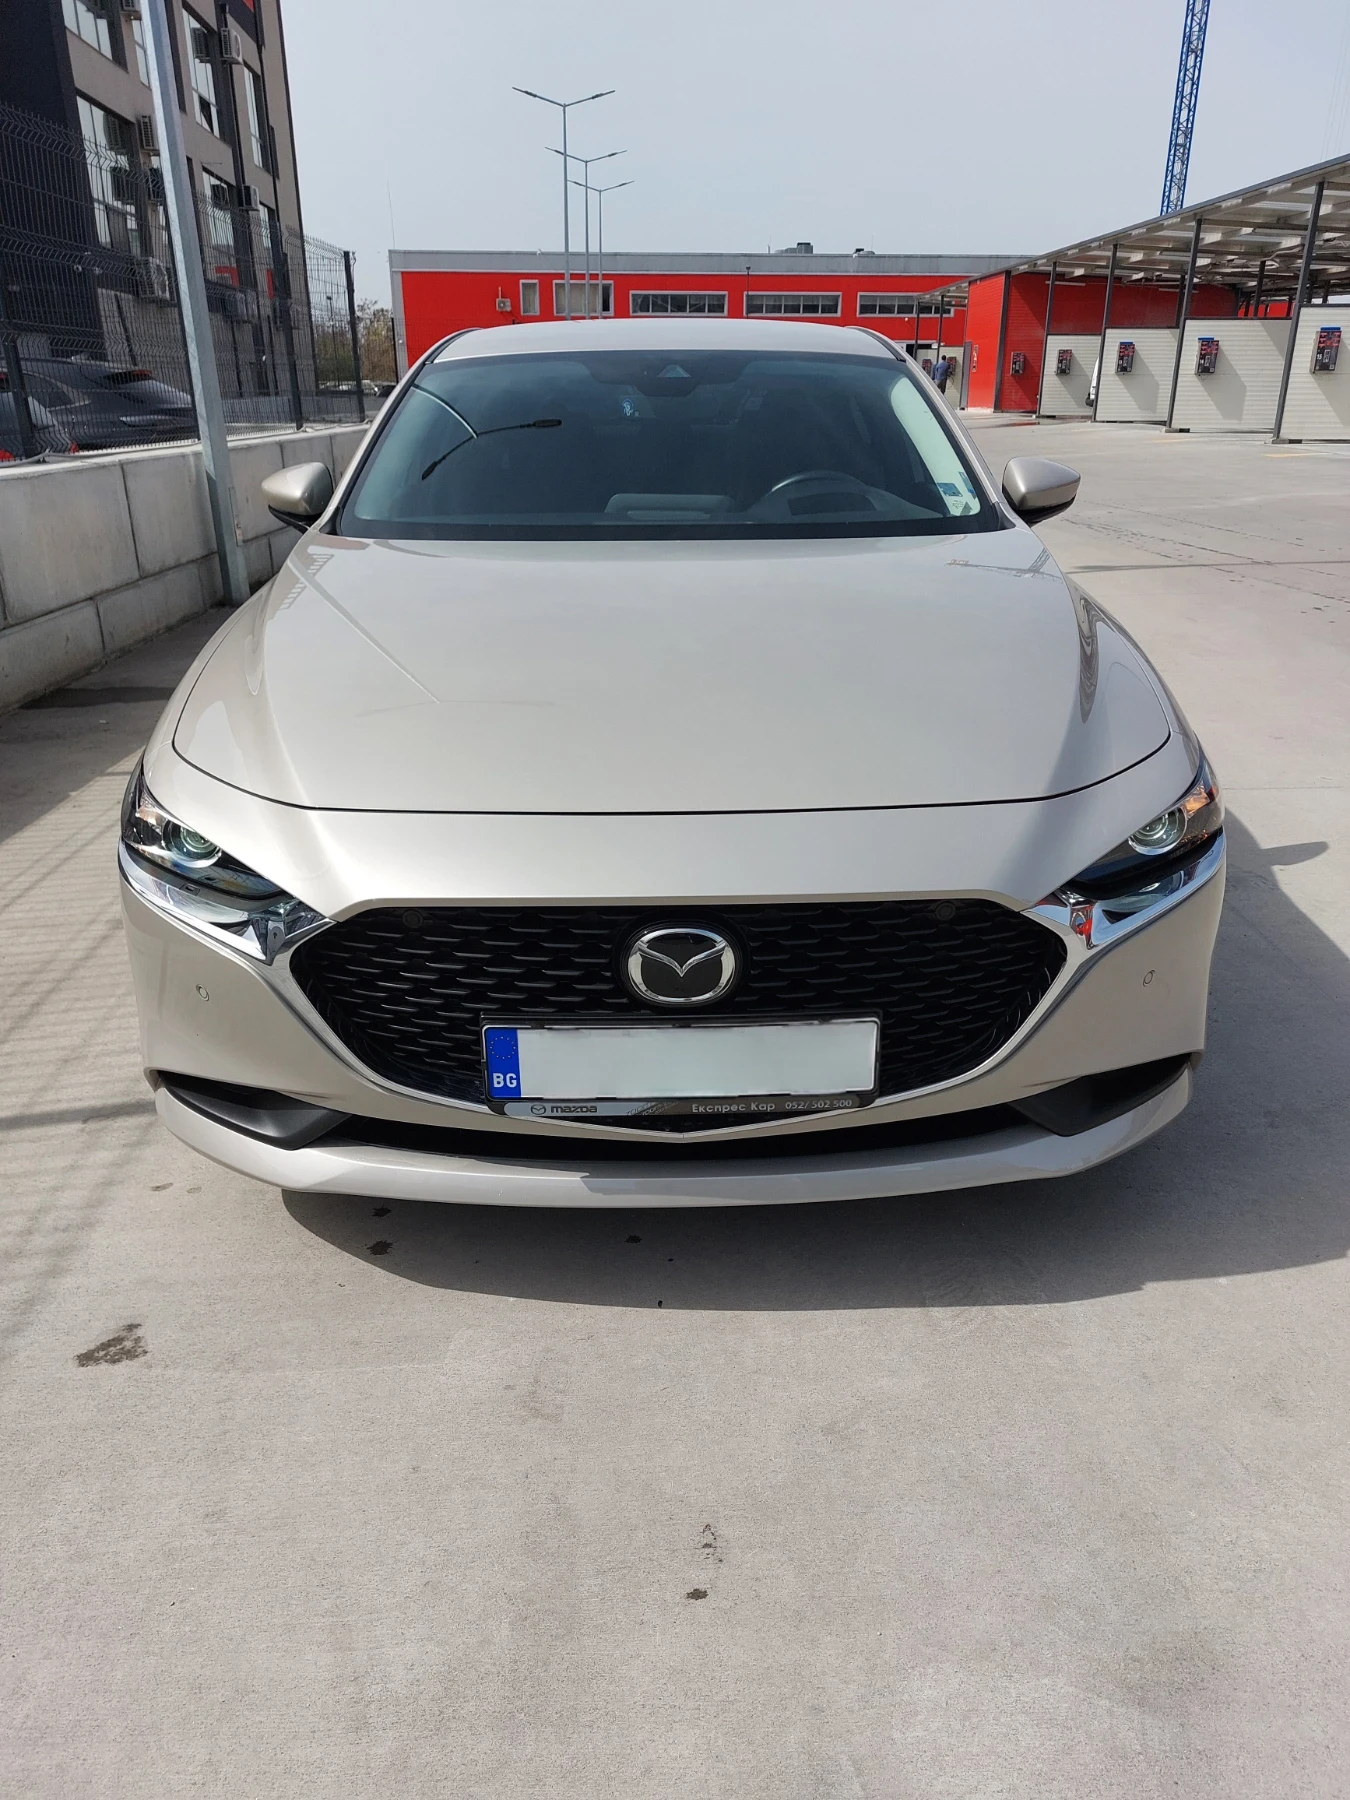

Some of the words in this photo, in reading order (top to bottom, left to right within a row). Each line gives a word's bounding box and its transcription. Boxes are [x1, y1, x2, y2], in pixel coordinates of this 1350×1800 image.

[493, 1073, 517, 1087] BG
[551, 1105, 598, 1113] mazda
[692, 1103, 746, 1113] Експрес
[751, 1102, 775, 1112] Кар
[784, 1100, 809, 1109] 052/
[811, 1100, 831, 1109] 502
[832, 1099, 852, 1108] 500
